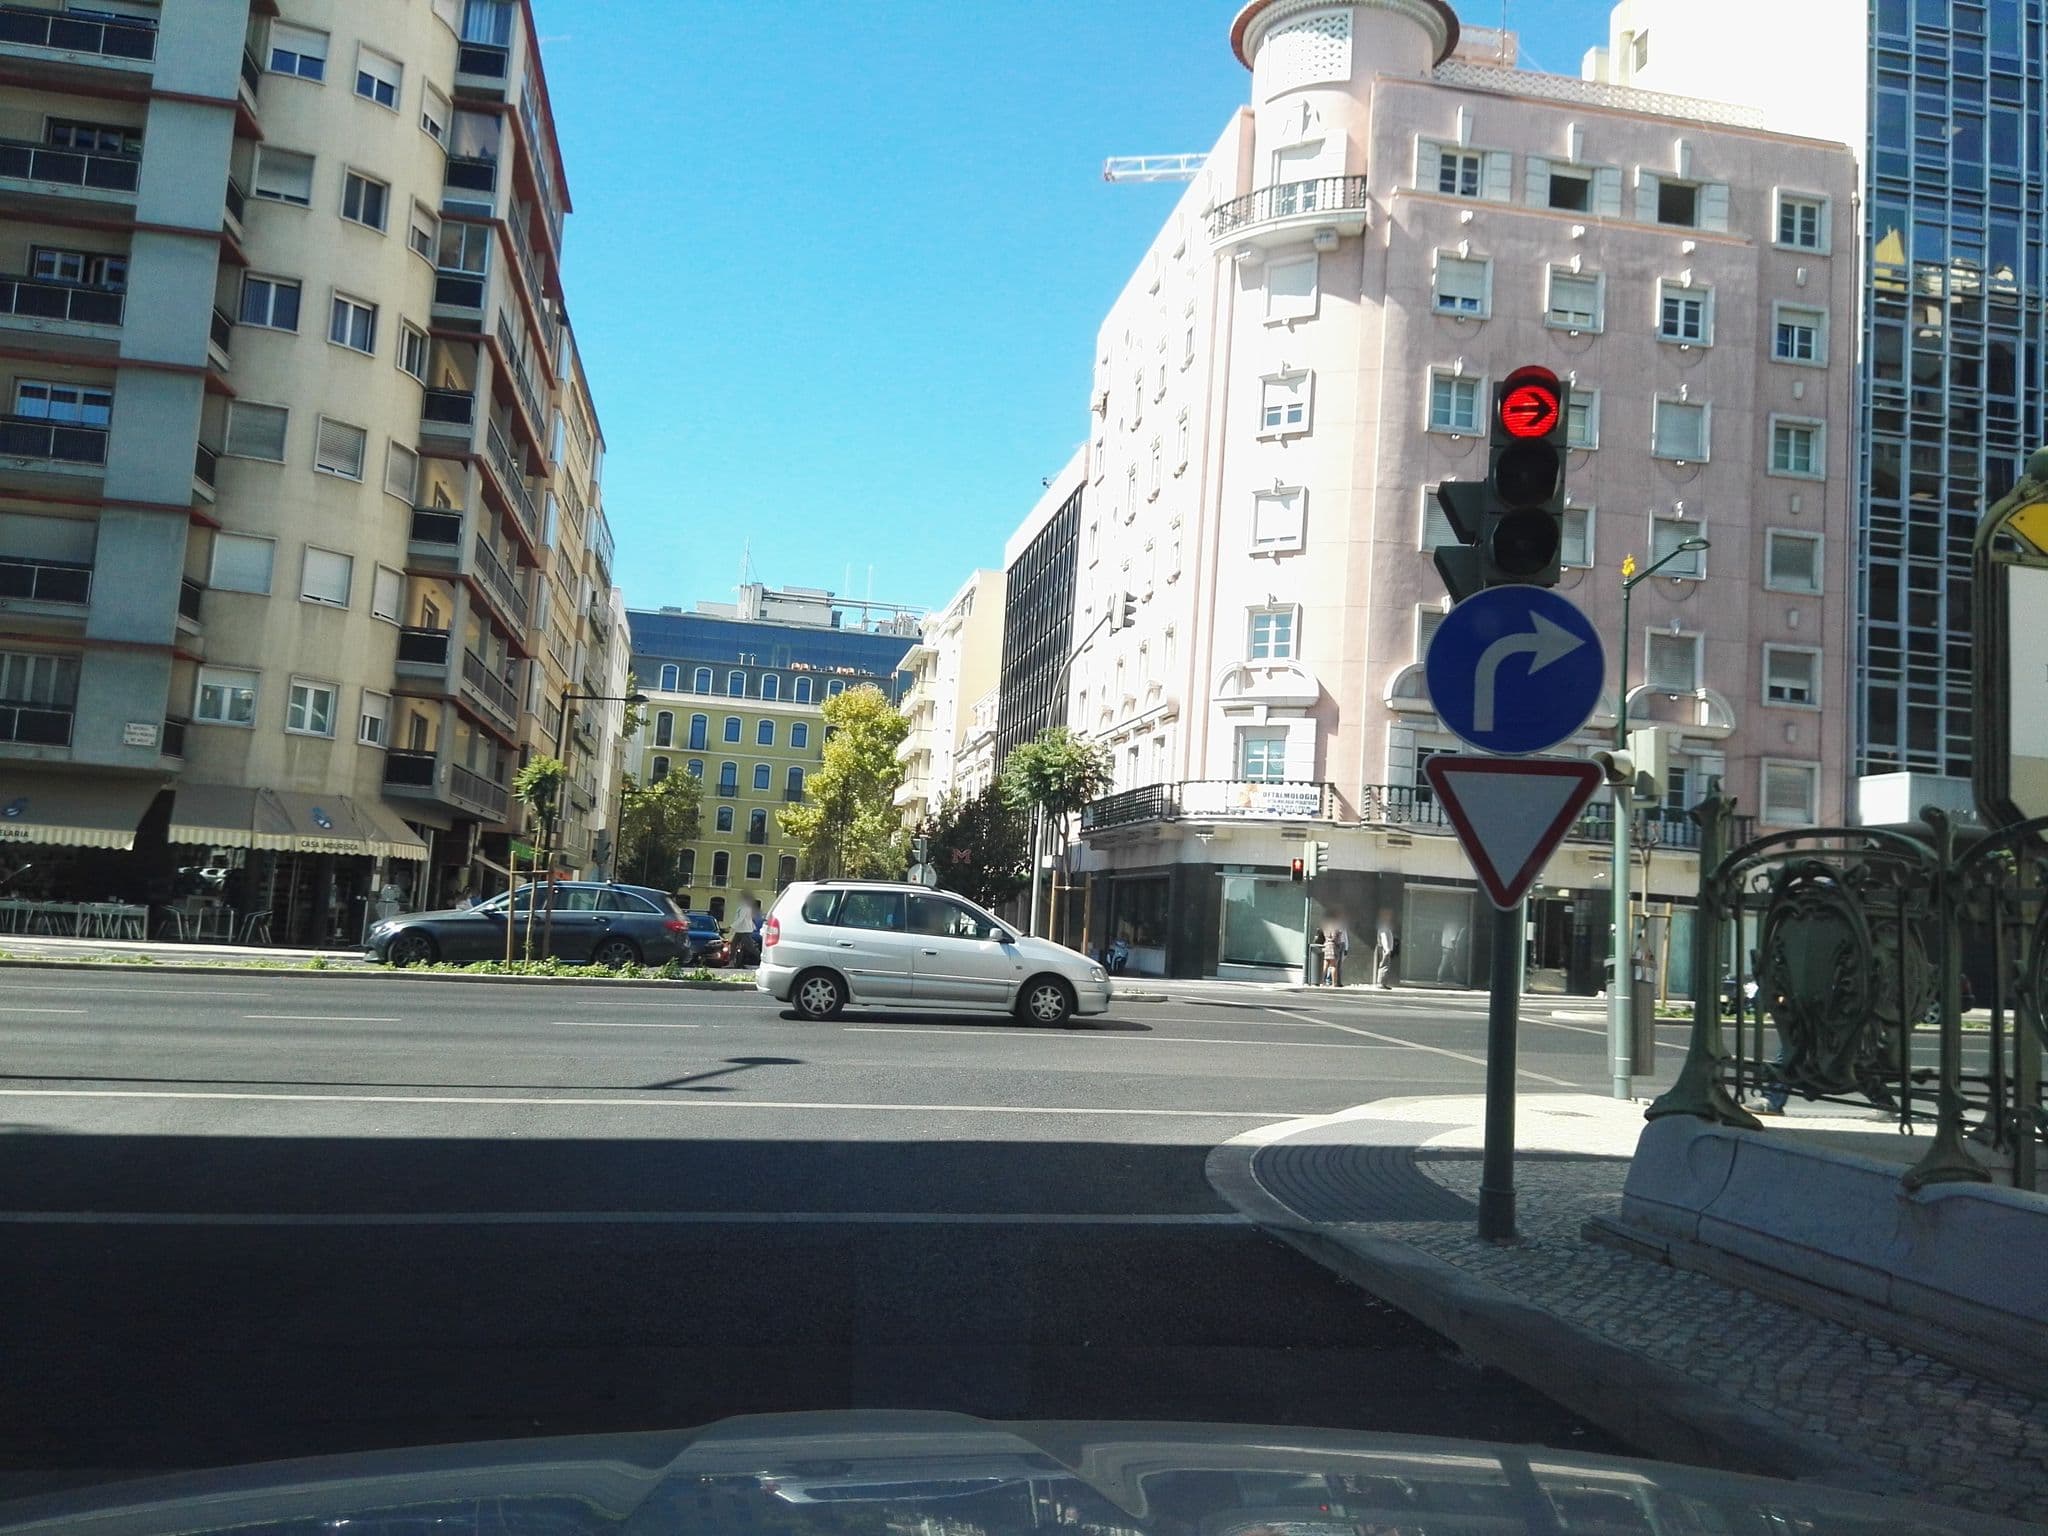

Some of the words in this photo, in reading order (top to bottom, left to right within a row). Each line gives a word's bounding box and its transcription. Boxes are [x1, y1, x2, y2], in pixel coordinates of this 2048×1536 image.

[1262, 792, 1318, 800] OFTALMOLOGIA
[301, 840, 319, 848] CASA
[952, 848, 972, 864] M
